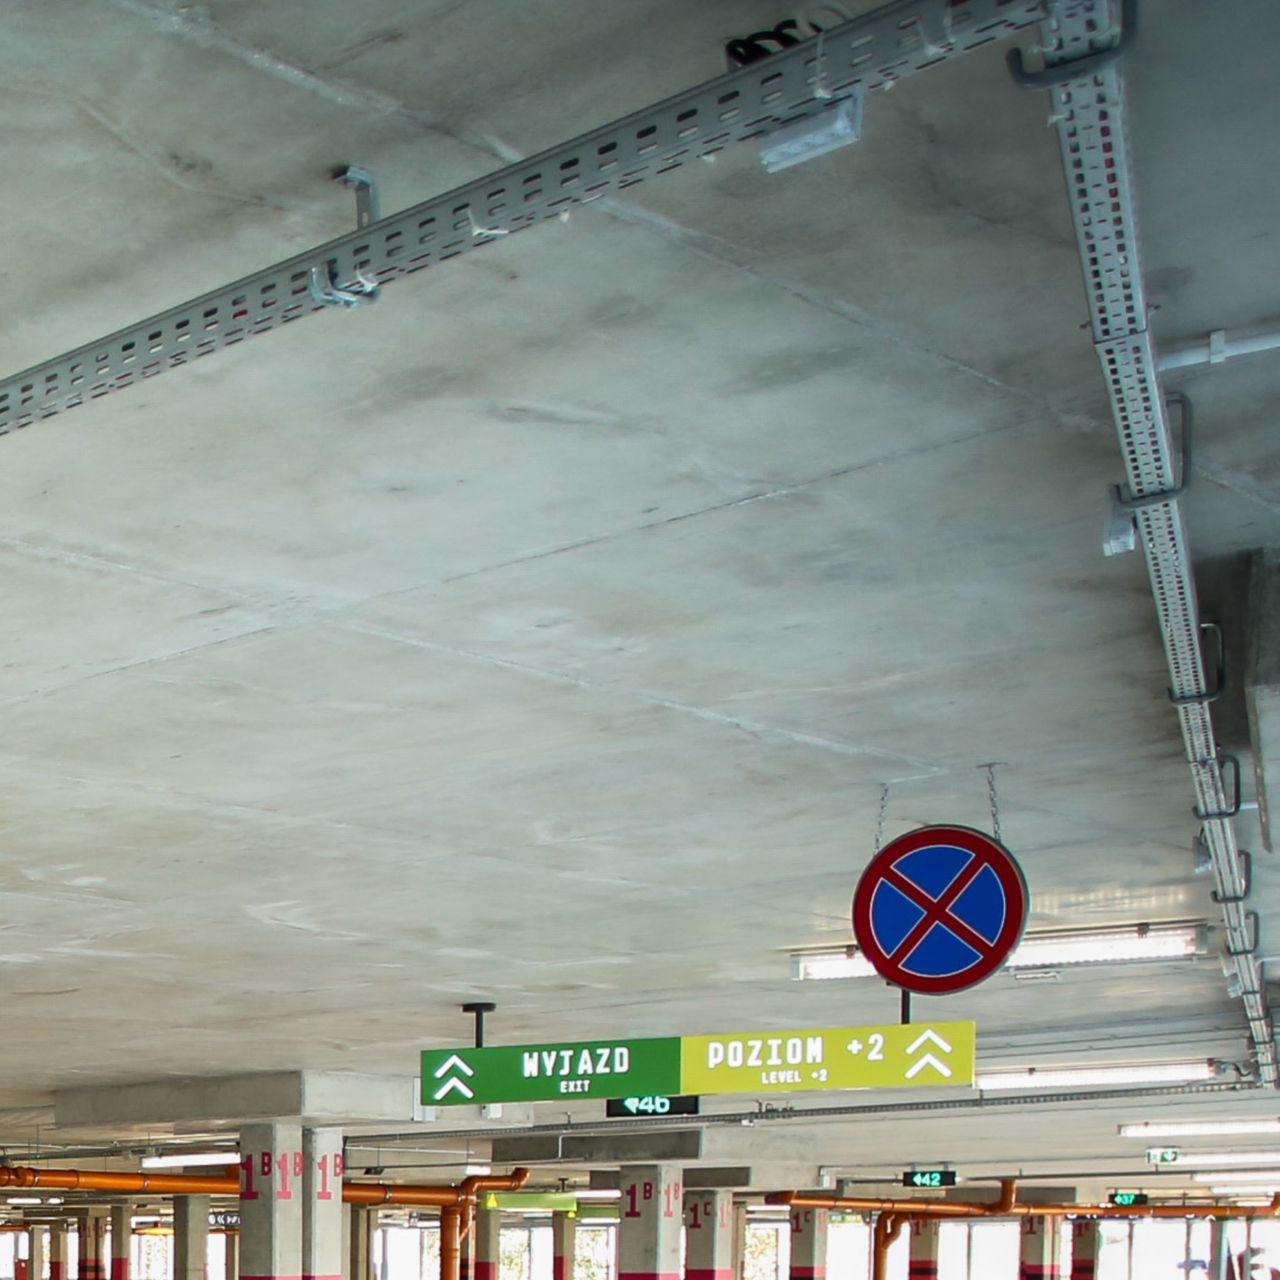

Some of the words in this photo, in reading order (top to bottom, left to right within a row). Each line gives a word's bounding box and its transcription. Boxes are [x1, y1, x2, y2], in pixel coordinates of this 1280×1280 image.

[708, 1037, 824, 1068] POZIOM
[847, 1033, 885, 1061] +2
[523, 1047, 630, 1078] WYJAZD
[761, 1070, 802, 1084] LEVEL
[810, 1068, 828, 1082] +2
[560, 1080, 591, 1093] EXIT
[921, 1172, 941, 1186] 42
